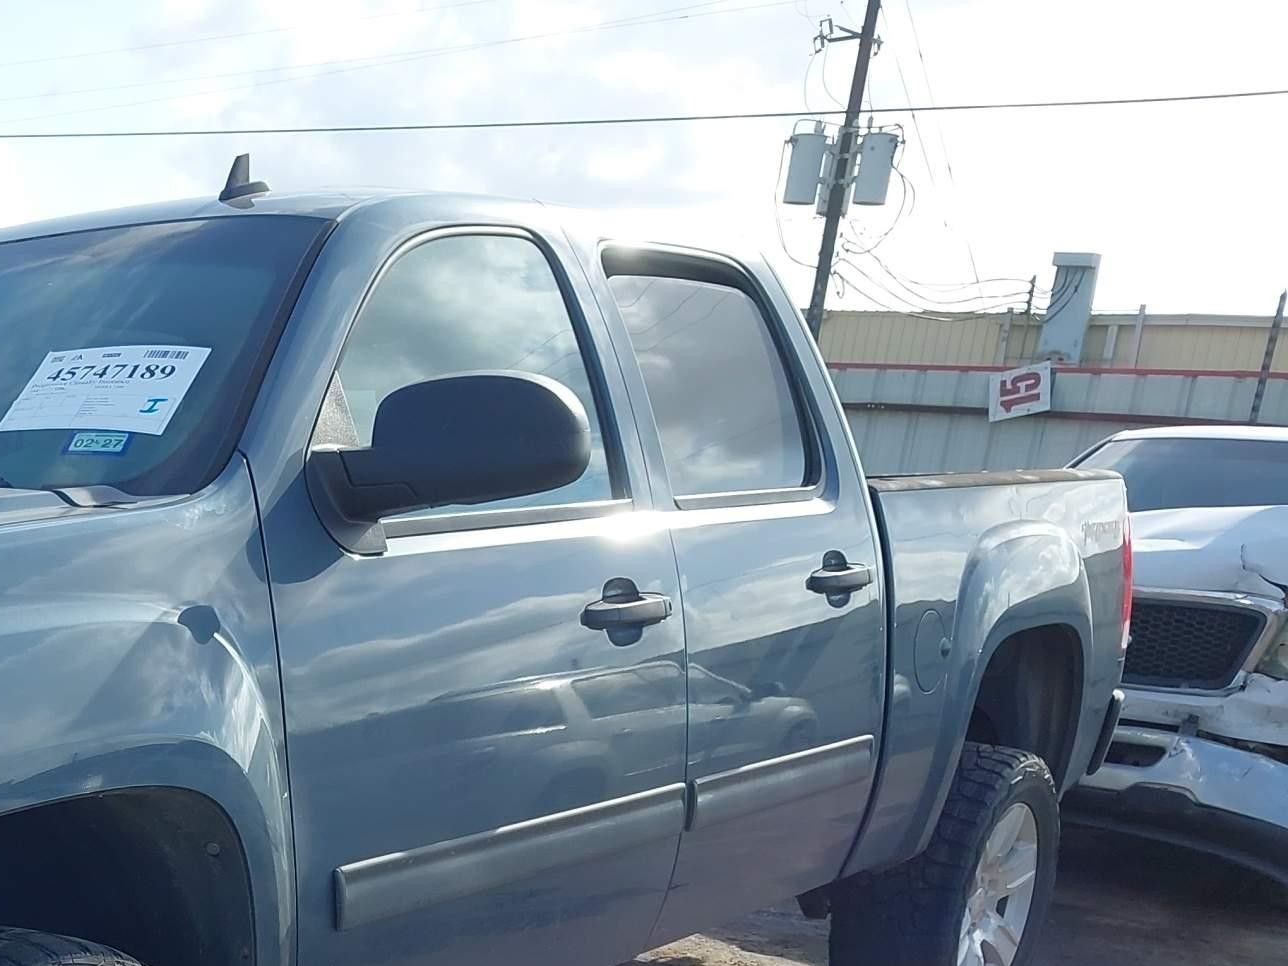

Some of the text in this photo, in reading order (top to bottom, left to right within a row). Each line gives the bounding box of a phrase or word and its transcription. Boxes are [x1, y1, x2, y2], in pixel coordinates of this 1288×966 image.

[47, 363, 177, 382] 45747189
[1000, 372, 1041, 413] 15
[74, 439, 123, 448] 02 27
